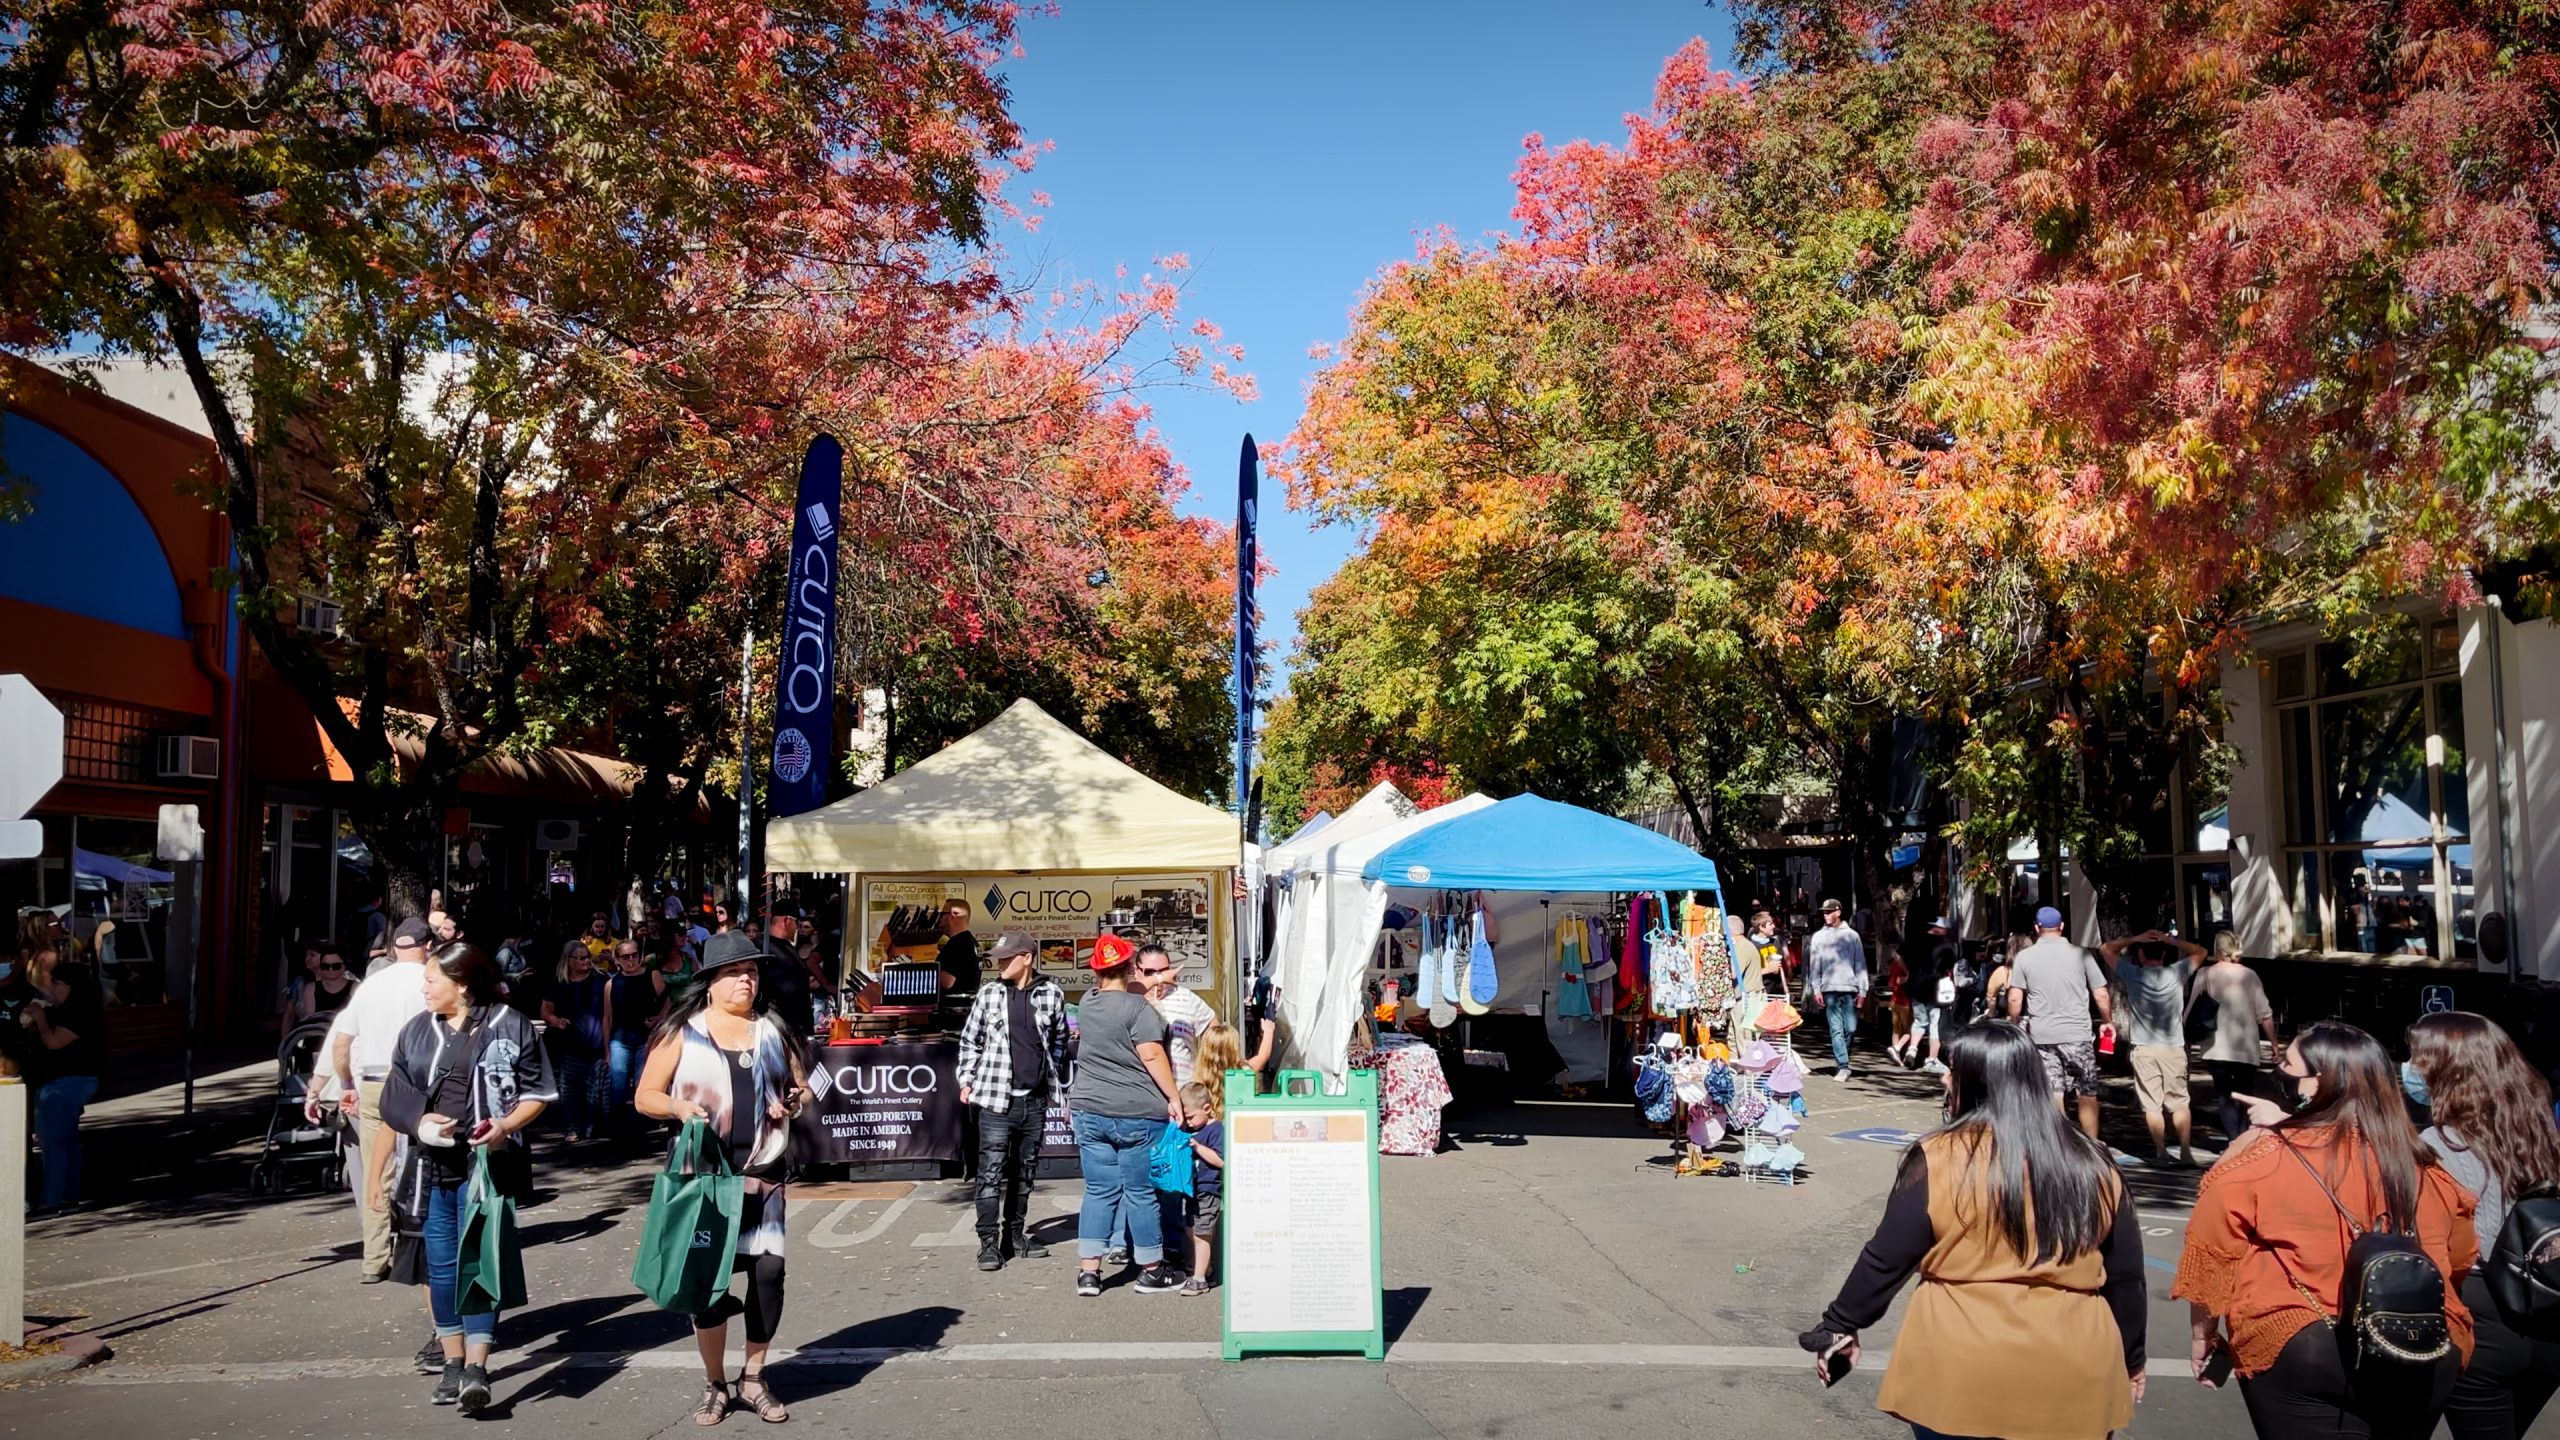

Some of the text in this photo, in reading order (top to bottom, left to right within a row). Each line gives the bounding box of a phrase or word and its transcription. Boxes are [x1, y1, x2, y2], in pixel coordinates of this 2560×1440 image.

[794, 556, 802, 576] The
[790, 577, 799, 612] World's
[784, 614, 794, 644] Finest
[788, 544, 828, 714] CUTCO
[872, 884, 883, 892] All
[887, 884, 916, 893] Cutco
[1009, 890, 1091, 913] CUTCO
[835, 1065, 936, 1094] CUTCO
[902, 1096, 922, 1105] Cutlery
[822, 1111, 924, 1125] GUARANTEED FOREVER
[832, 1124, 912, 1138] MADE IN AMERICA
[1056, 1121, 1067, 1132] IN
[849, 1139, 897, 1150] SINCE 1949
[1046, 1134, 1073, 1145] SINCE
